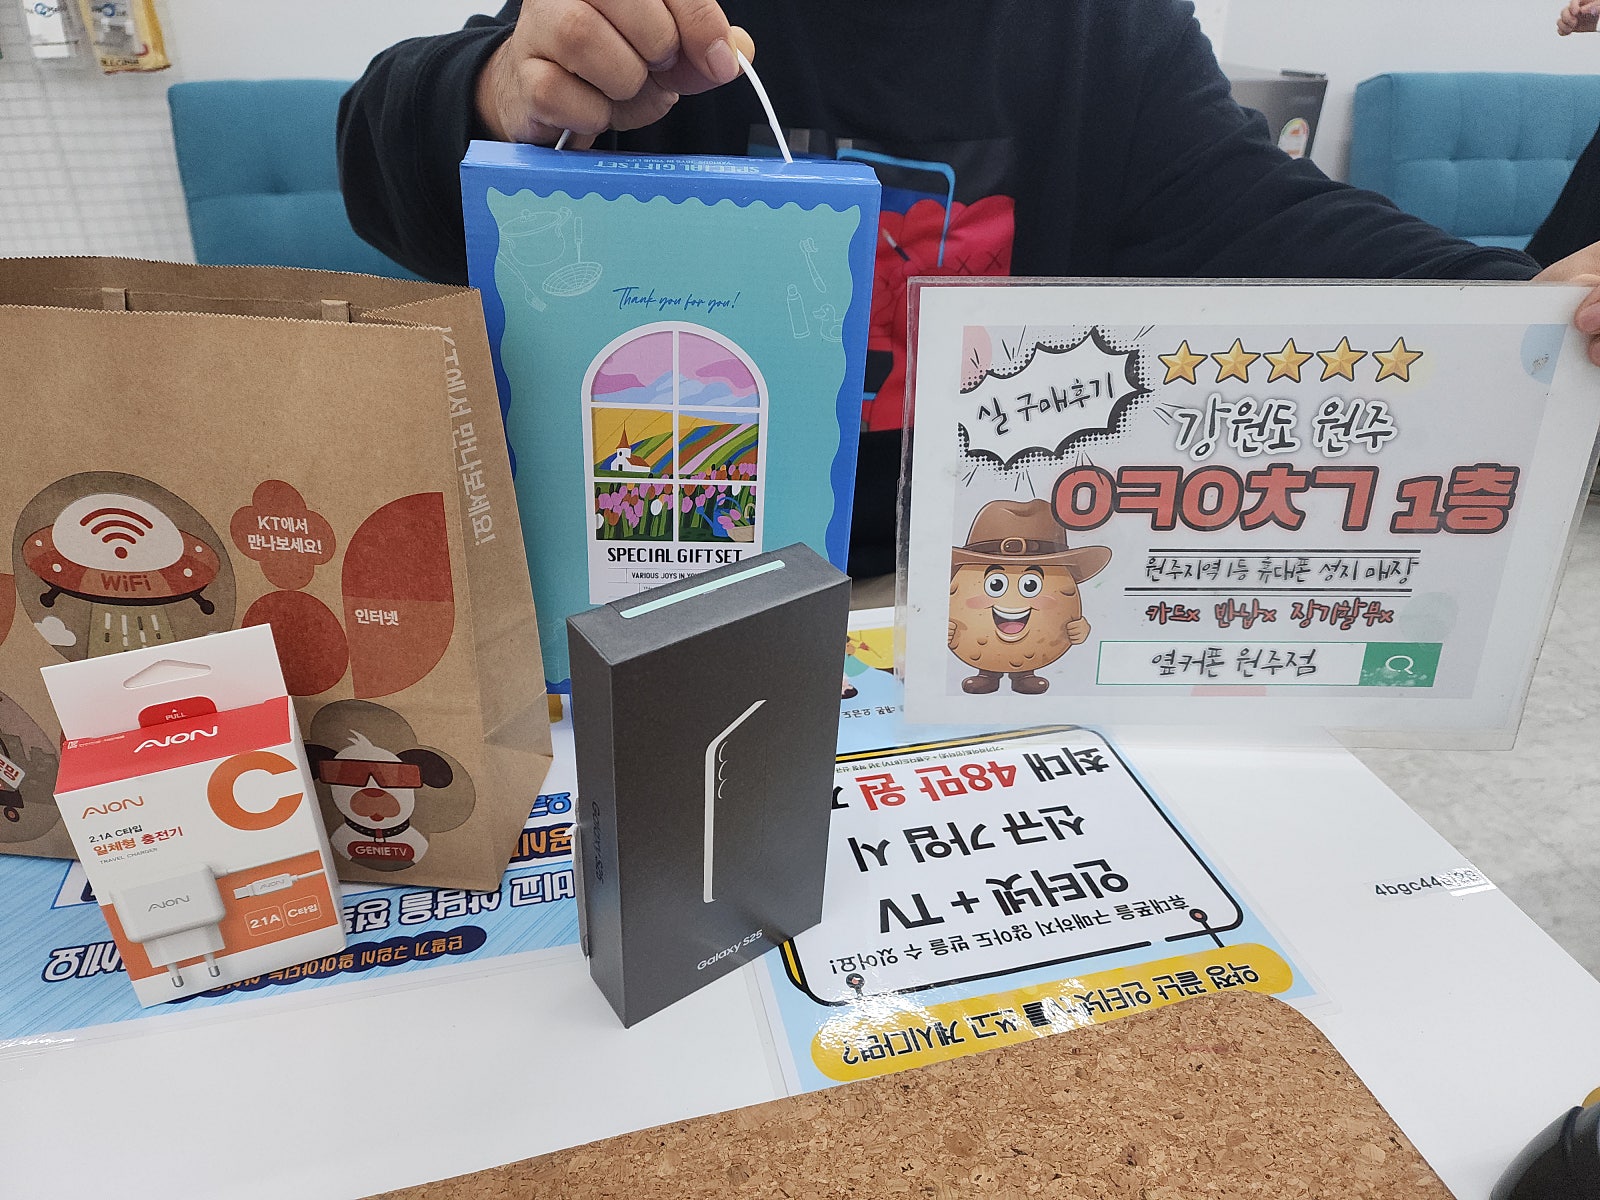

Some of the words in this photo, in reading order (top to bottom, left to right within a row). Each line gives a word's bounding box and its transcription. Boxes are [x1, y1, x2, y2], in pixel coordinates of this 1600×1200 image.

[684, 163, 760, 173] SPECIAL
[612, 286, 657, 310] Thank
[659, 297, 682, 312] you
[684, 293, 705, 311] for
[707, 292, 741, 313] you!
[978, 396, 1009, 436] 실
[1016, 371, 1114, 423] 구매후기
[1176, 395, 1298, 459] 강원도
[1315, 398, 1396, 455] 원주
[452, 421, 497, 547] 만나보세요!
[1390, 463, 1520, 534] 1층
[256, 515, 309, 534] KT에서
[247, 533, 323, 555] 만나보세요!
[607, 547, 674, 563] SPECIAL
[100, 572, 151, 592] WiFi
[660, 572, 677, 580] JOYS
[678, 572, 685, 580] IN
[1145, 557, 1222, 582] 원주지역
[1257, 556, 1312, 584] 휴대폰
[1318, 559, 1359, 582] 성지
[1365, 557, 1420, 584] 매장
[353, 608, 400, 627] 인터넷
[1151, 647, 1225, 678] 옆커폰
[1235, 647, 1318, 678] 원주점
[165, 712, 187, 721] PULL
[1022, 747, 1111, 783] 최대
[207, 750, 304, 831] C
[854, 773, 907, 811] 원
[914, 760, 1018, 802] 48만
[88, 832, 113, 844] 2.1A
[115, 824, 143, 837] C타입
[1002, 804, 1086, 846] 신규
[92, 837, 137, 856] 일체형
[141, 826, 184, 845] 충전기
[100, 855, 125, 865] TRAVEL
[126, 847, 158, 859] CHARGER
[848, 836, 891, 873] 시
[902, 821, 996, 863] 가입
[510, 869, 576, 907] 비교
[985, 858, 1129, 917] 인터넷
[287, 903, 319, 918] C타입
[879, 892, 946, 934] TV
[1112, 893, 1190, 921] 휴대폰을
[972, 924, 1033, 949] 않아도
[1034, 909, 1111, 937] 구매하지
[361, 945, 409, 966] 구입시
[415, 935, 464, 958] 단말기
[696, 941, 742, 972] Galaxy
[742, 928, 764, 948] S25
[829, 946, 900, 976] 있어요!
[903, 943, 923, 960] 수
[928, 935, 969, 957] 받을
[41, 941, 127, 984] 세요
[1205, 962, 1260, 990] 약정
[1151, 970, 1207, 1001] 끝난
[970, 1006, 1019, 1039] 쓰고
[841, 1019, 965, 1066] 계시다면?
